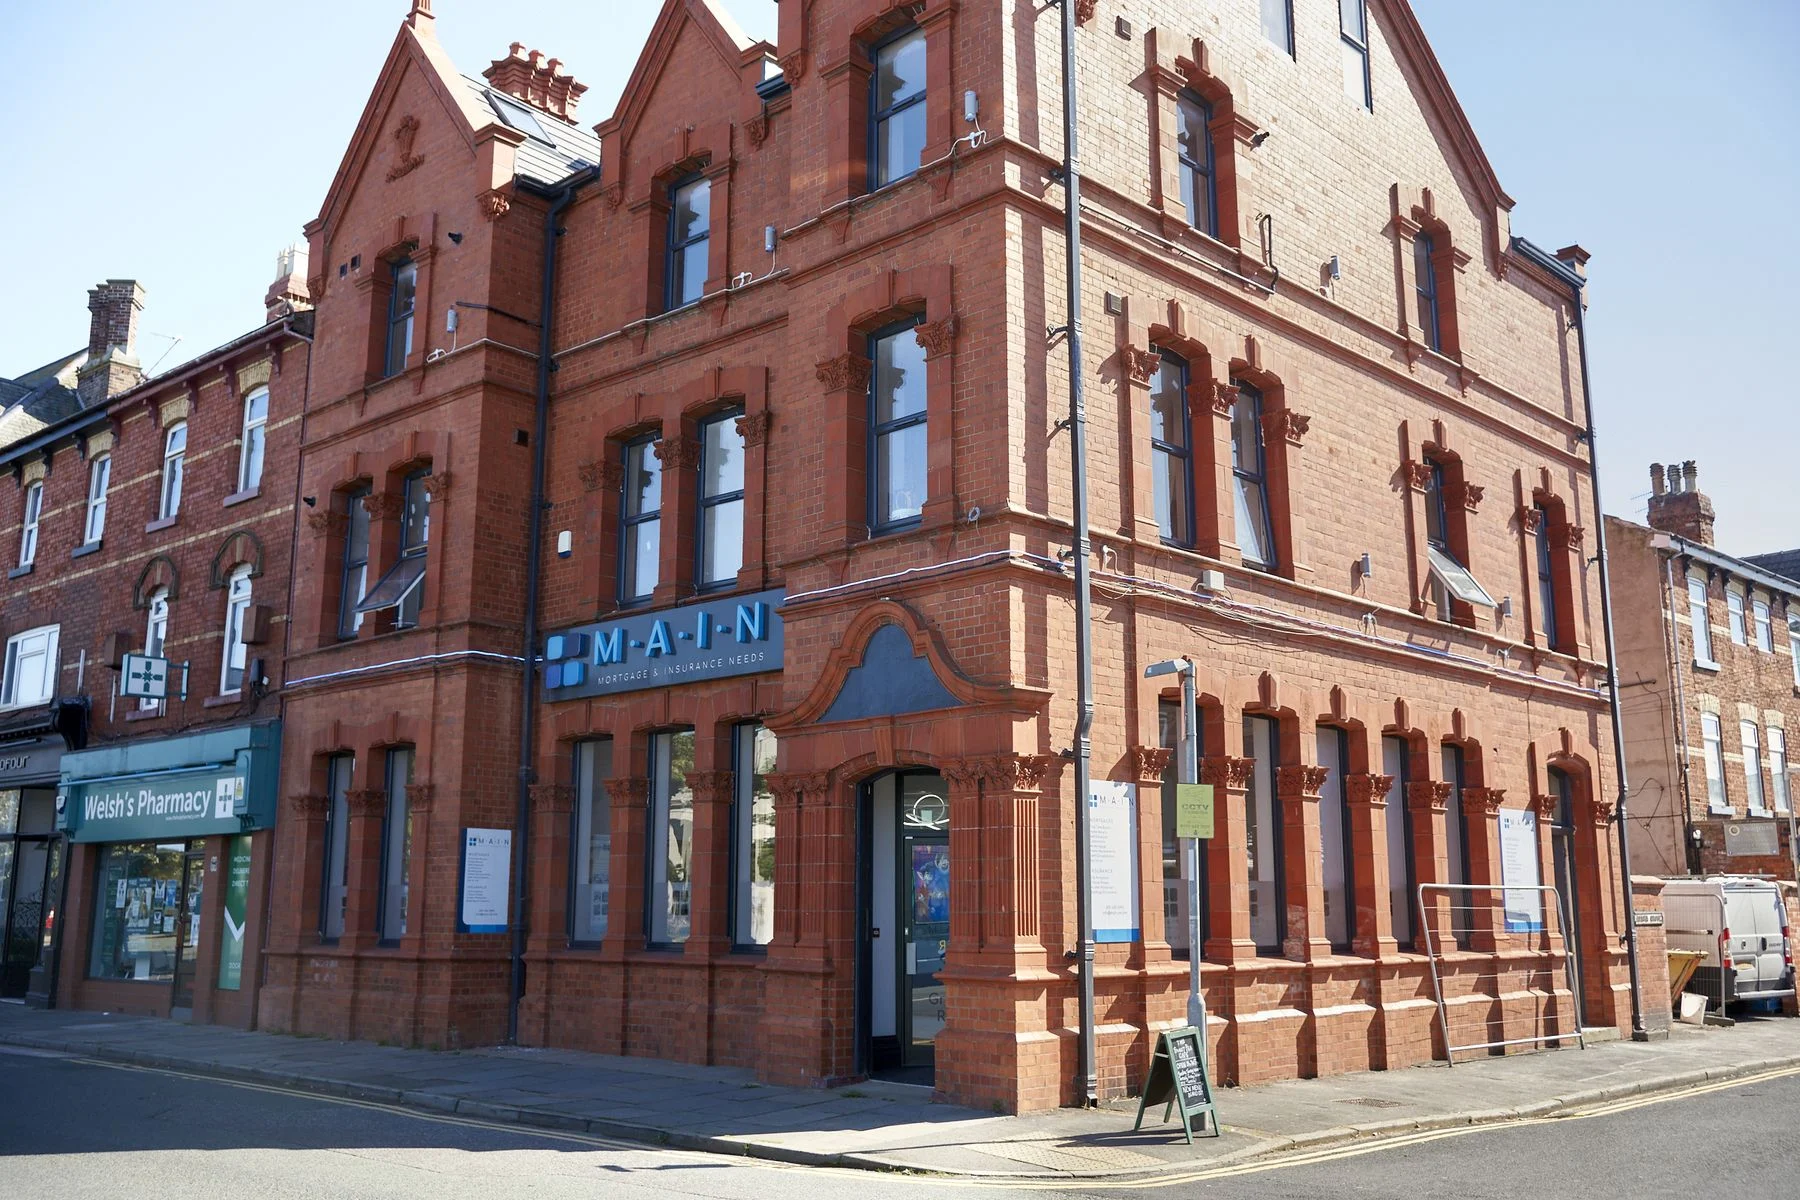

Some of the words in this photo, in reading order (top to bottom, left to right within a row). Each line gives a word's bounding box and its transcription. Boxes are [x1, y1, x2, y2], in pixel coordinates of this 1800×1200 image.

[598, 669, 648, 685] MORTGAGE
[653, 668, 658, 677] &
[664, 658, 722, 675] INSURANCE
[729, 652, 764, 665] NEEDS
[85, 791, 134, 820] Welsh's
[137, 789, 212, 818] Pharmacy
